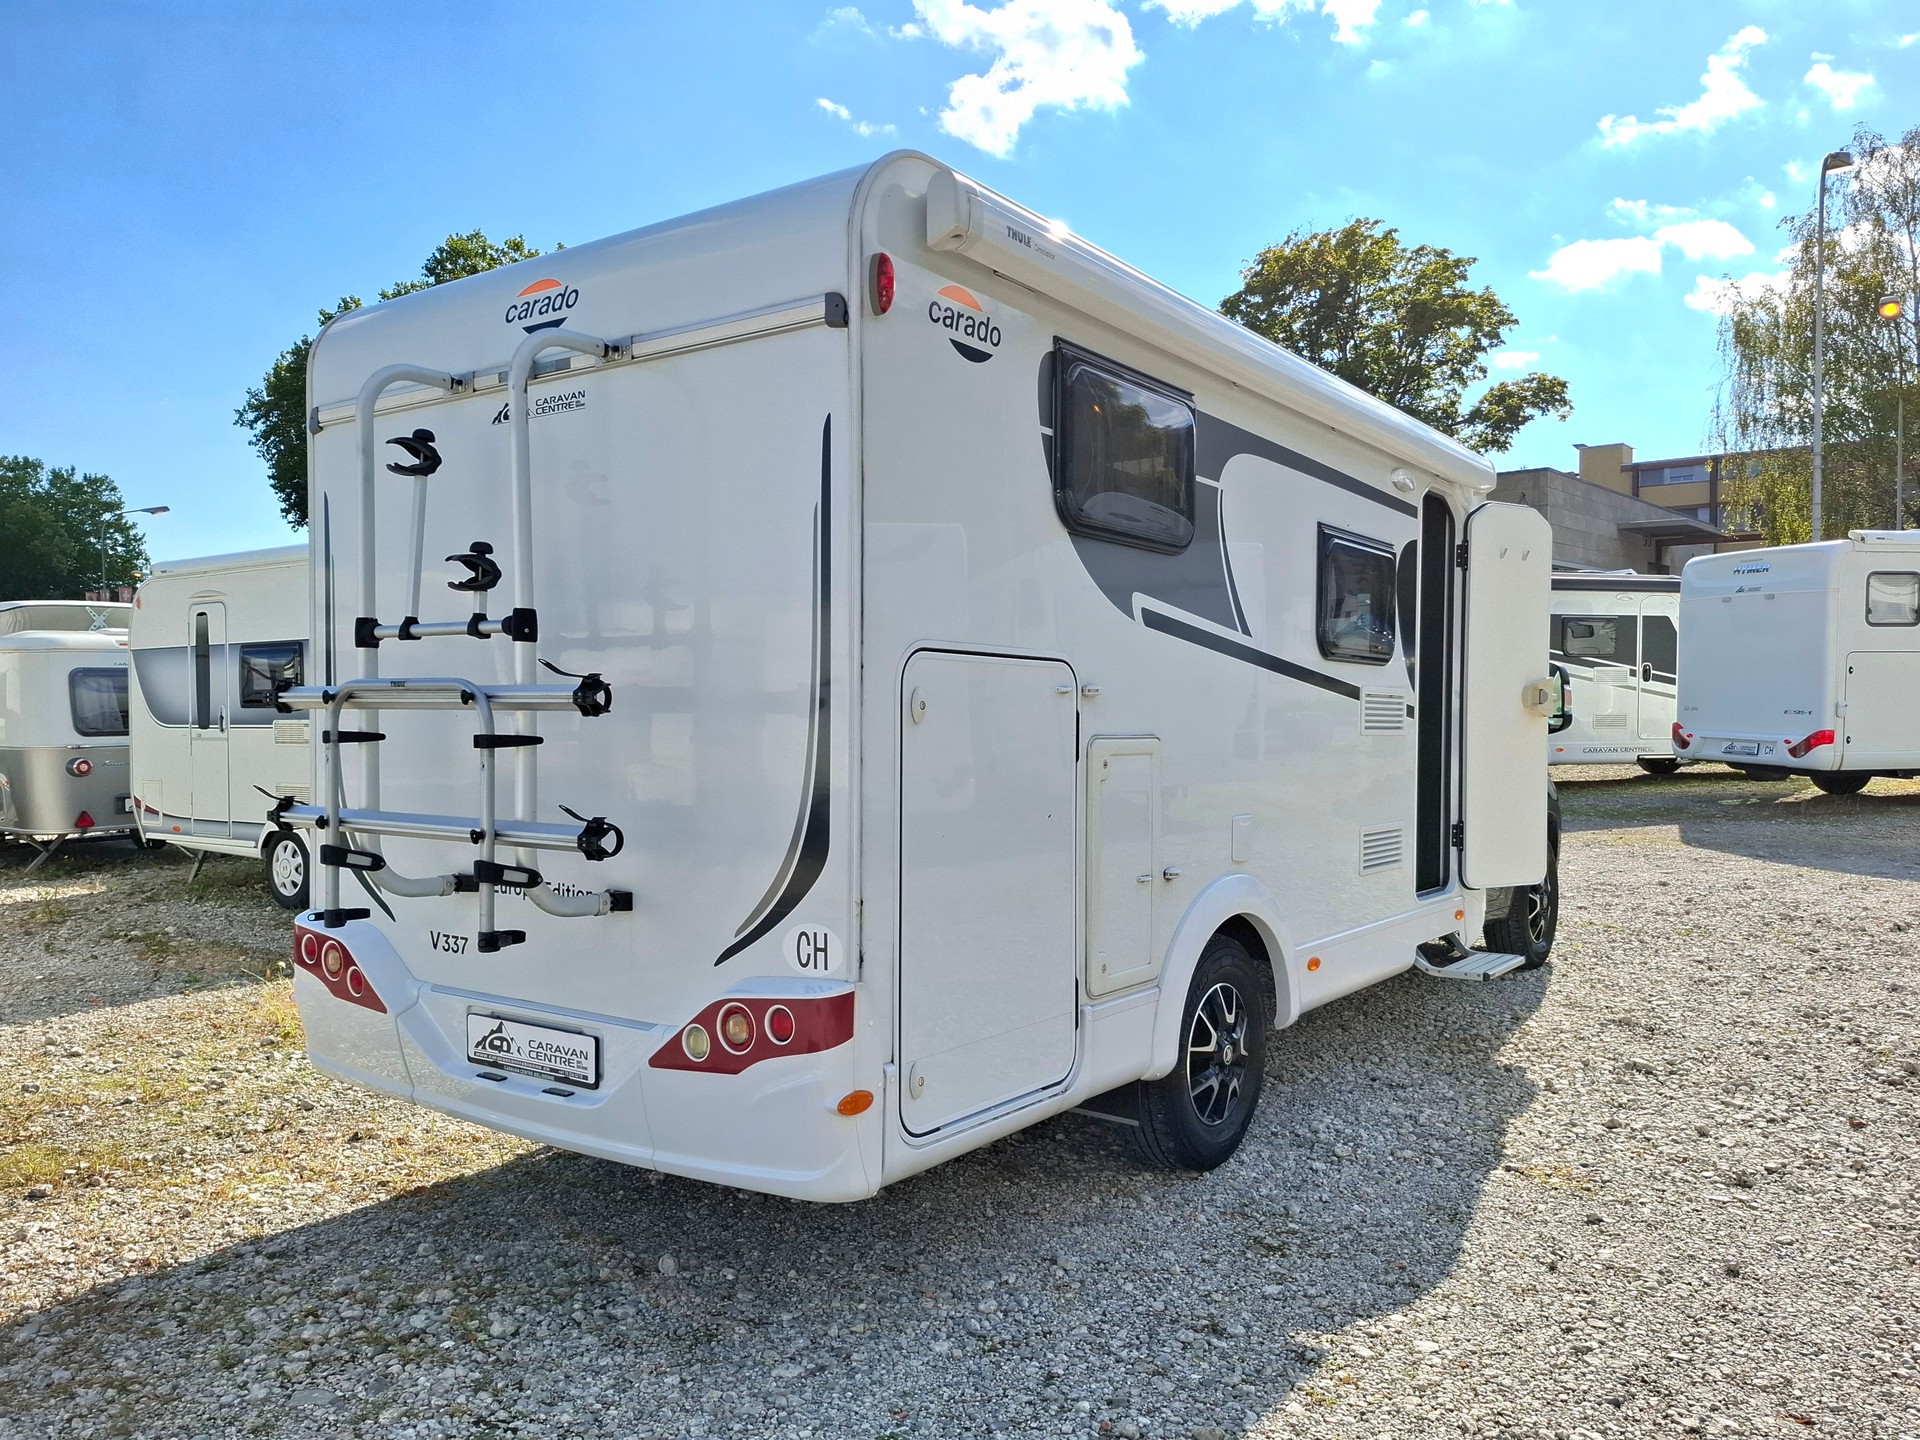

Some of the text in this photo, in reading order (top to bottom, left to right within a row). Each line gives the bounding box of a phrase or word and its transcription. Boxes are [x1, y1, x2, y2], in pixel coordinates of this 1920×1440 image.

[1006, 225, 1031, 248] THULE
[505, 285, 580, 323] carado
[928, 300, 1002, 348] carado
[535, 390, 585, 406] CARAVAN
[535, 401, 575, 415] CENTRE
[1733, 563, 1770, 575] HYMER
[1764, 746, 1774, 755] CH
[430, 930, 469, 955] V337
[796, 931, 828, 970] CH
[528, 1039, 588, 1060] CARAVAN
[528, 1049, 576, 1069] CENTRE
